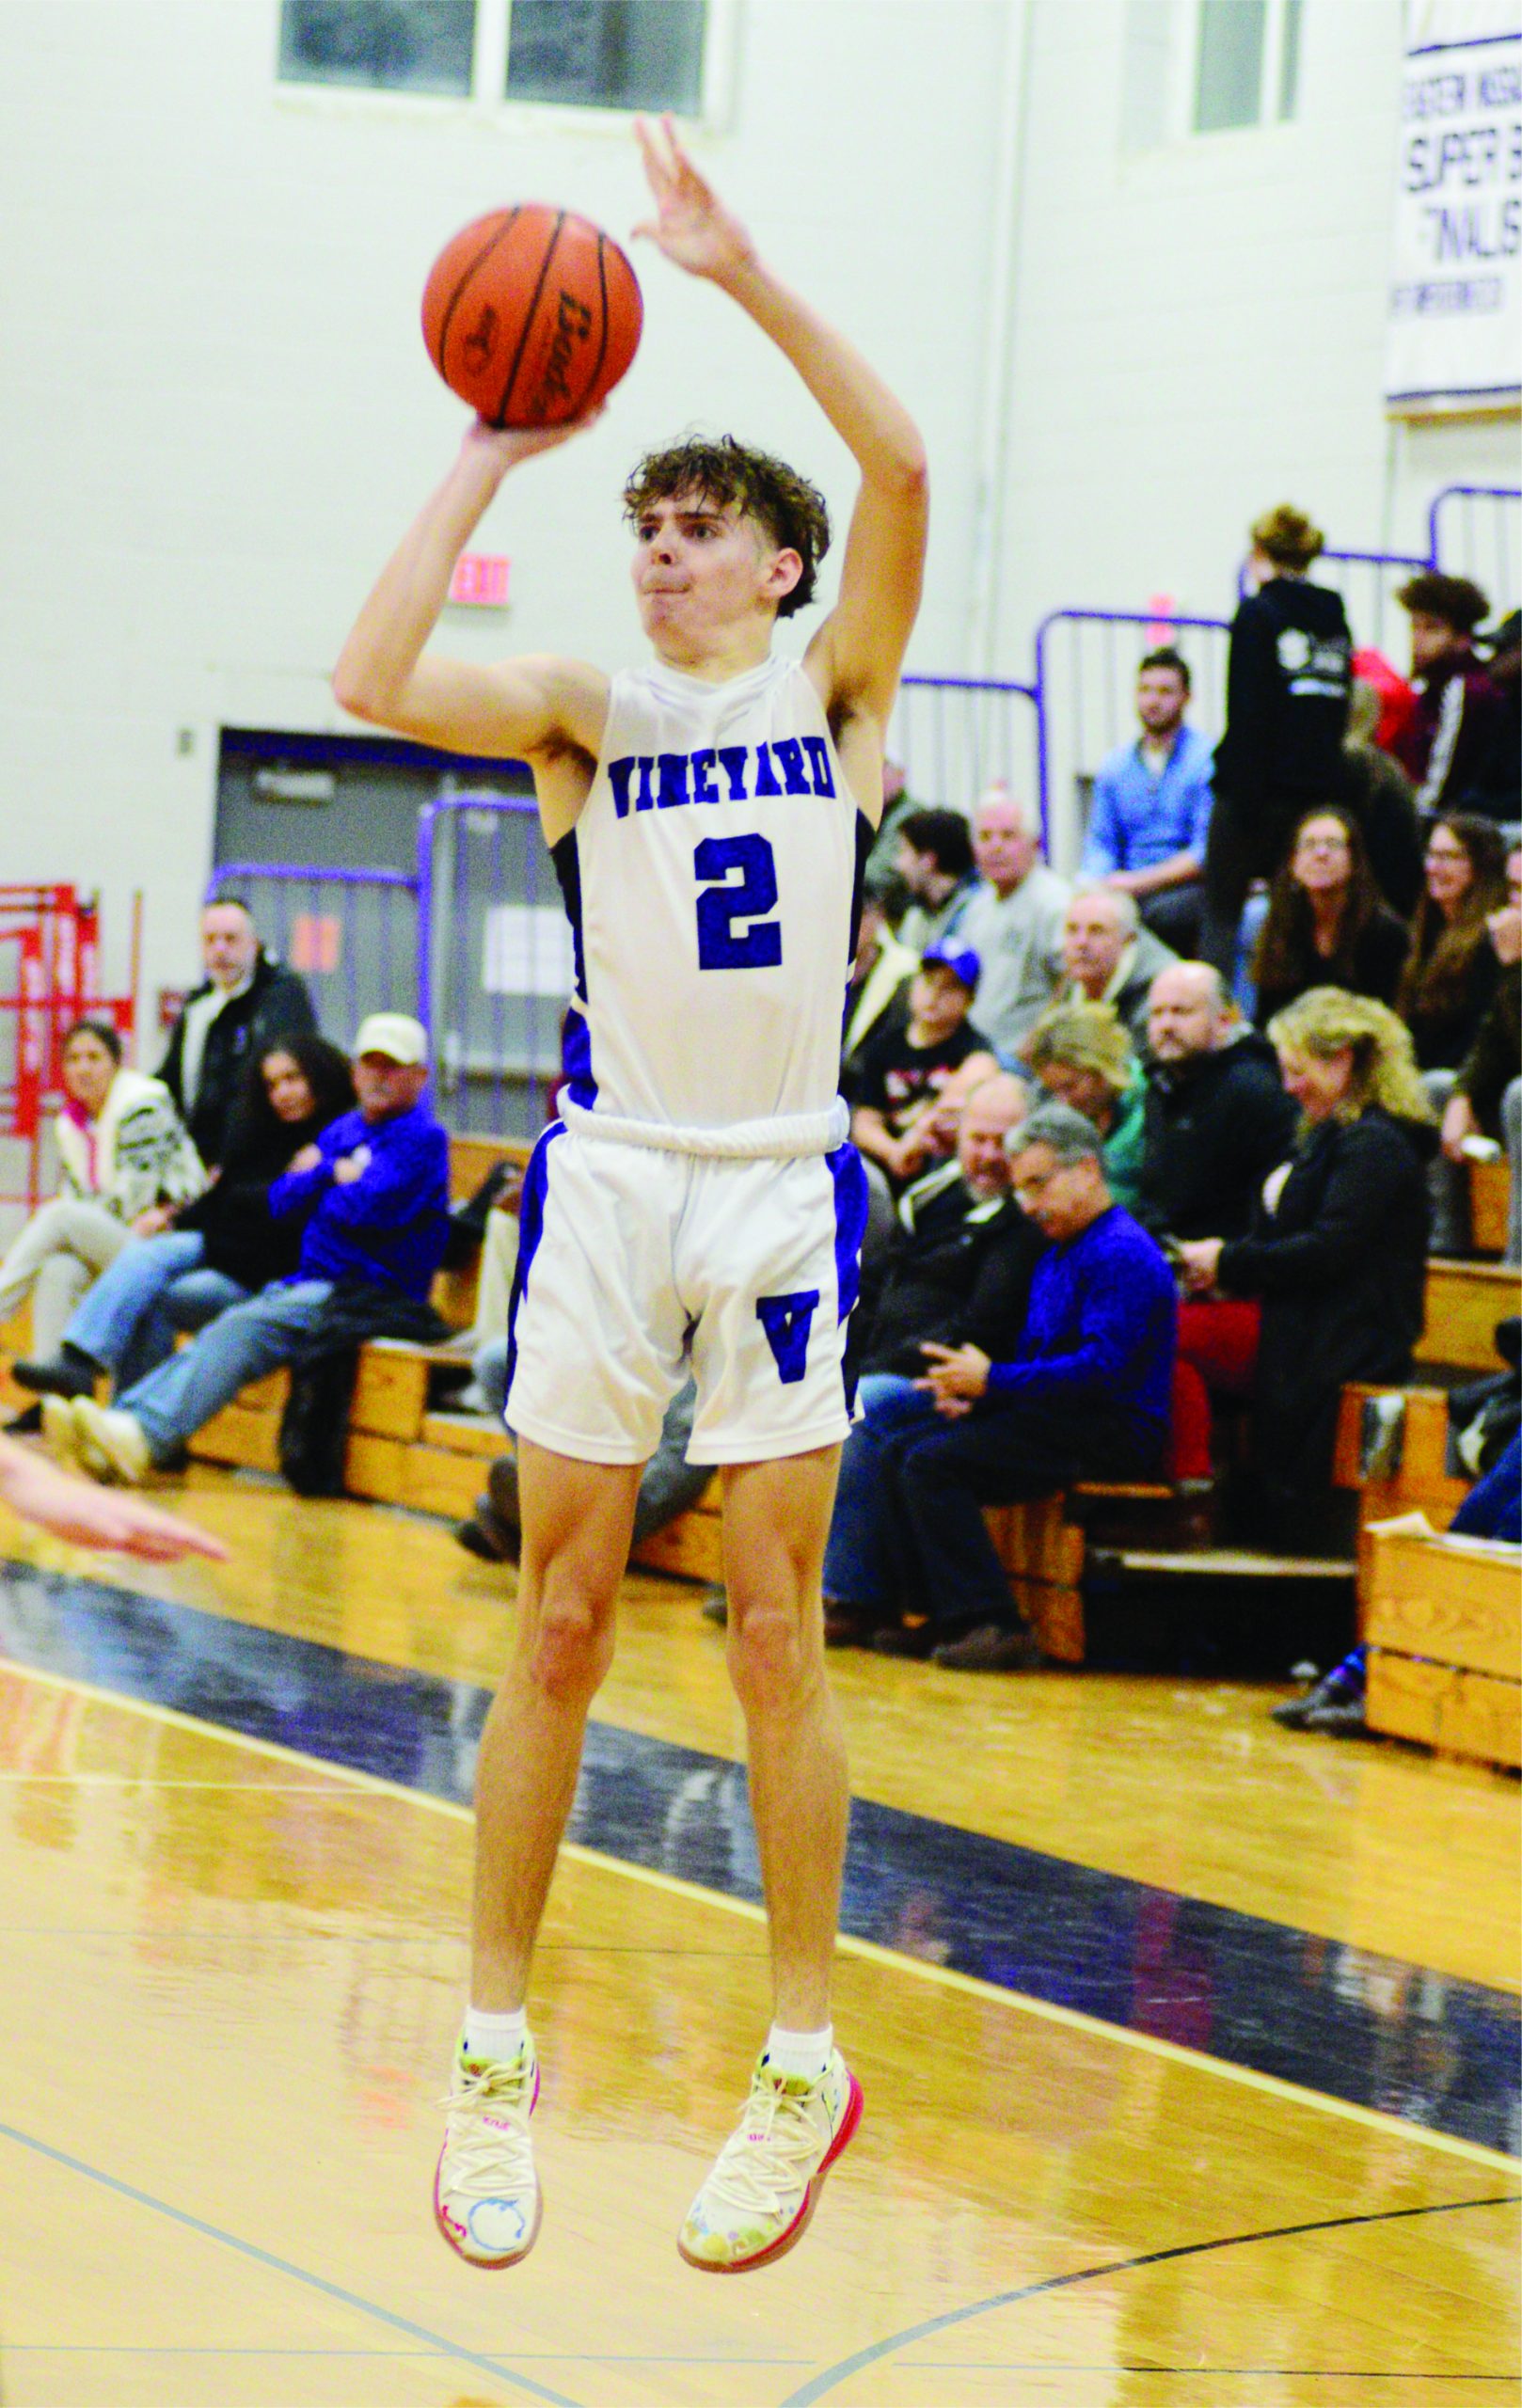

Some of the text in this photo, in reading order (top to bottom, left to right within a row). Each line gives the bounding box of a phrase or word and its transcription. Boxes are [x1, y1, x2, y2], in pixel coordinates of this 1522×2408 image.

[608, 737, 836, 818] VINEYARD
[694, 833, 782, 970] 2
[756, 1289, 819, 1384] V
